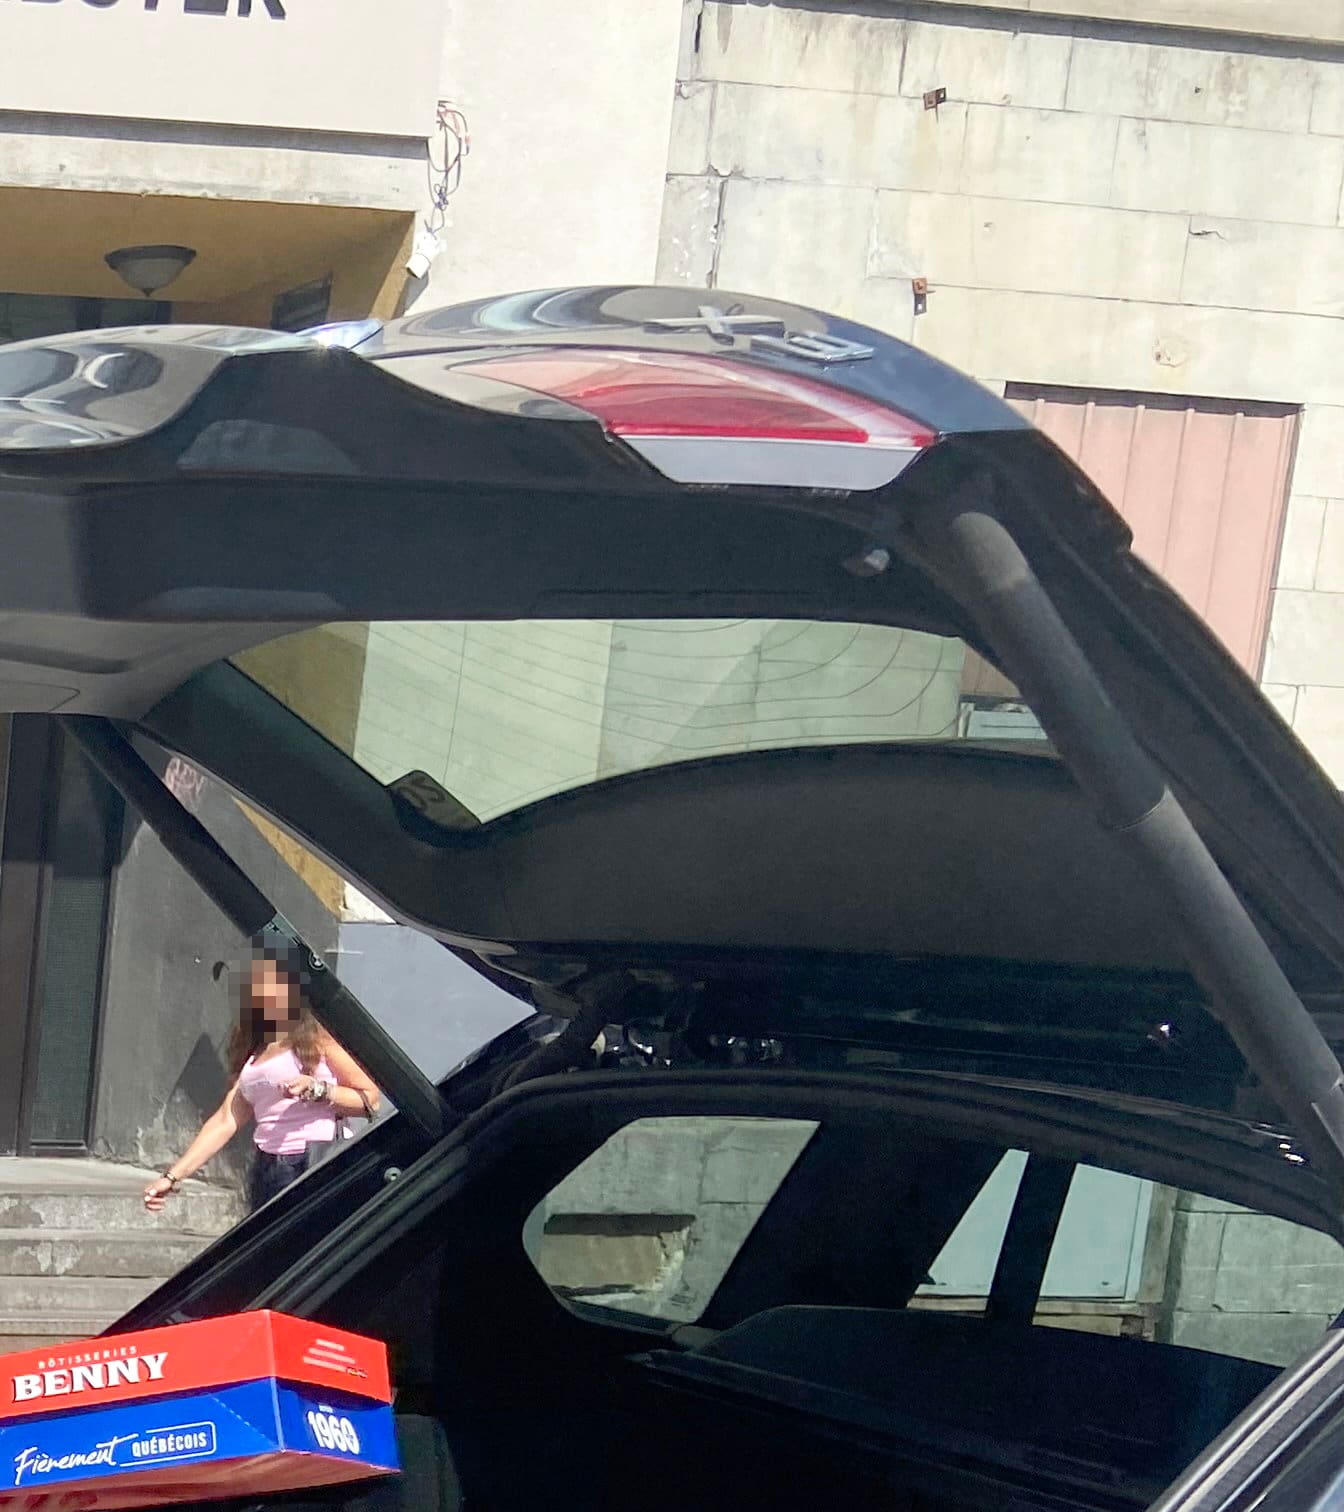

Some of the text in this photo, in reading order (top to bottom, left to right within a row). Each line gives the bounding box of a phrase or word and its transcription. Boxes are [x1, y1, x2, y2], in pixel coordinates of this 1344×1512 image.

[13, 1352, 168, 1402] BENNY
[38, 1345, 137, 1369] RÔTISSERIES
[307, 1411, 360, 1455] 1960
[14, 1432, 208, 1485] Fièrement QUÉBÉCOIS
